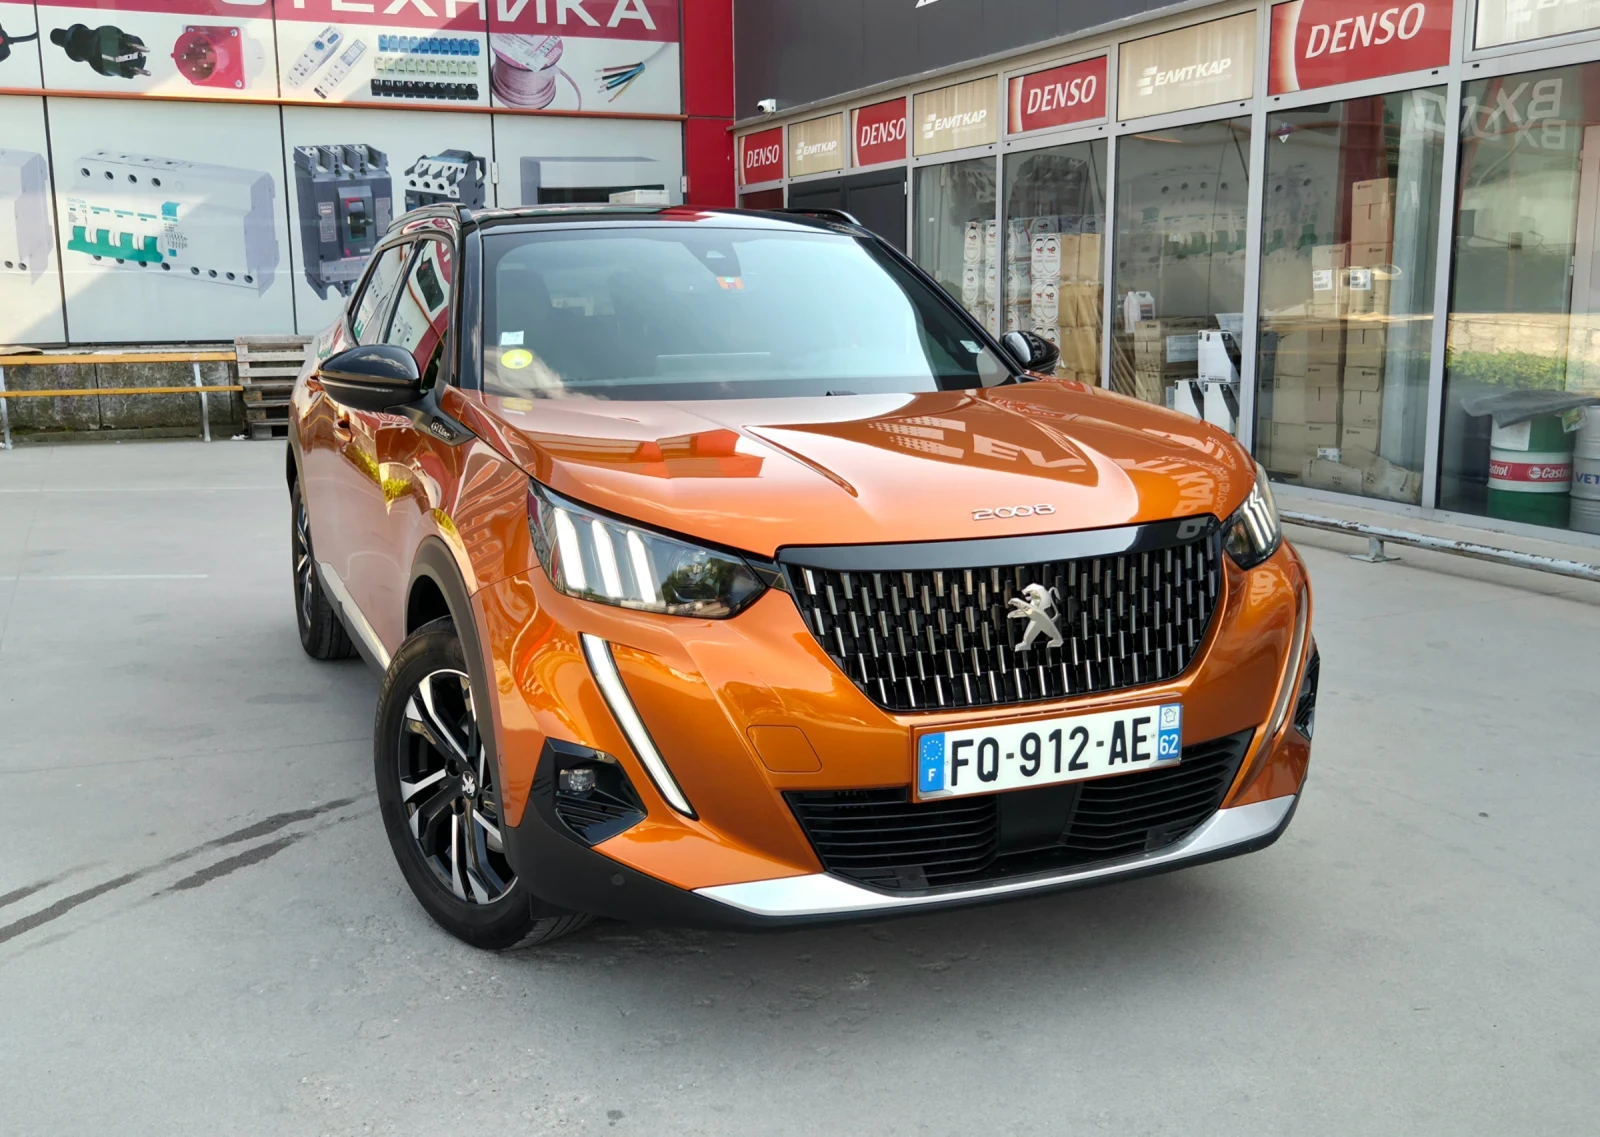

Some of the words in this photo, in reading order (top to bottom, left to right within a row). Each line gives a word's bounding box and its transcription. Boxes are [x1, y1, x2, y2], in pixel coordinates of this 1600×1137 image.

[1305, 2, 1425, 59] DENSO
[1026, 75, 1097, 115] DENSO
[860, 117, 906, 147] DENSO
[746, 144, 780, 169] DENSO
[971, 503, 1056, 521] 2008
[951, 716, 1151, 787] FQ-912-AE
[1159, 734, 1179, 756] 62
[928, 768, 936, 782] F
